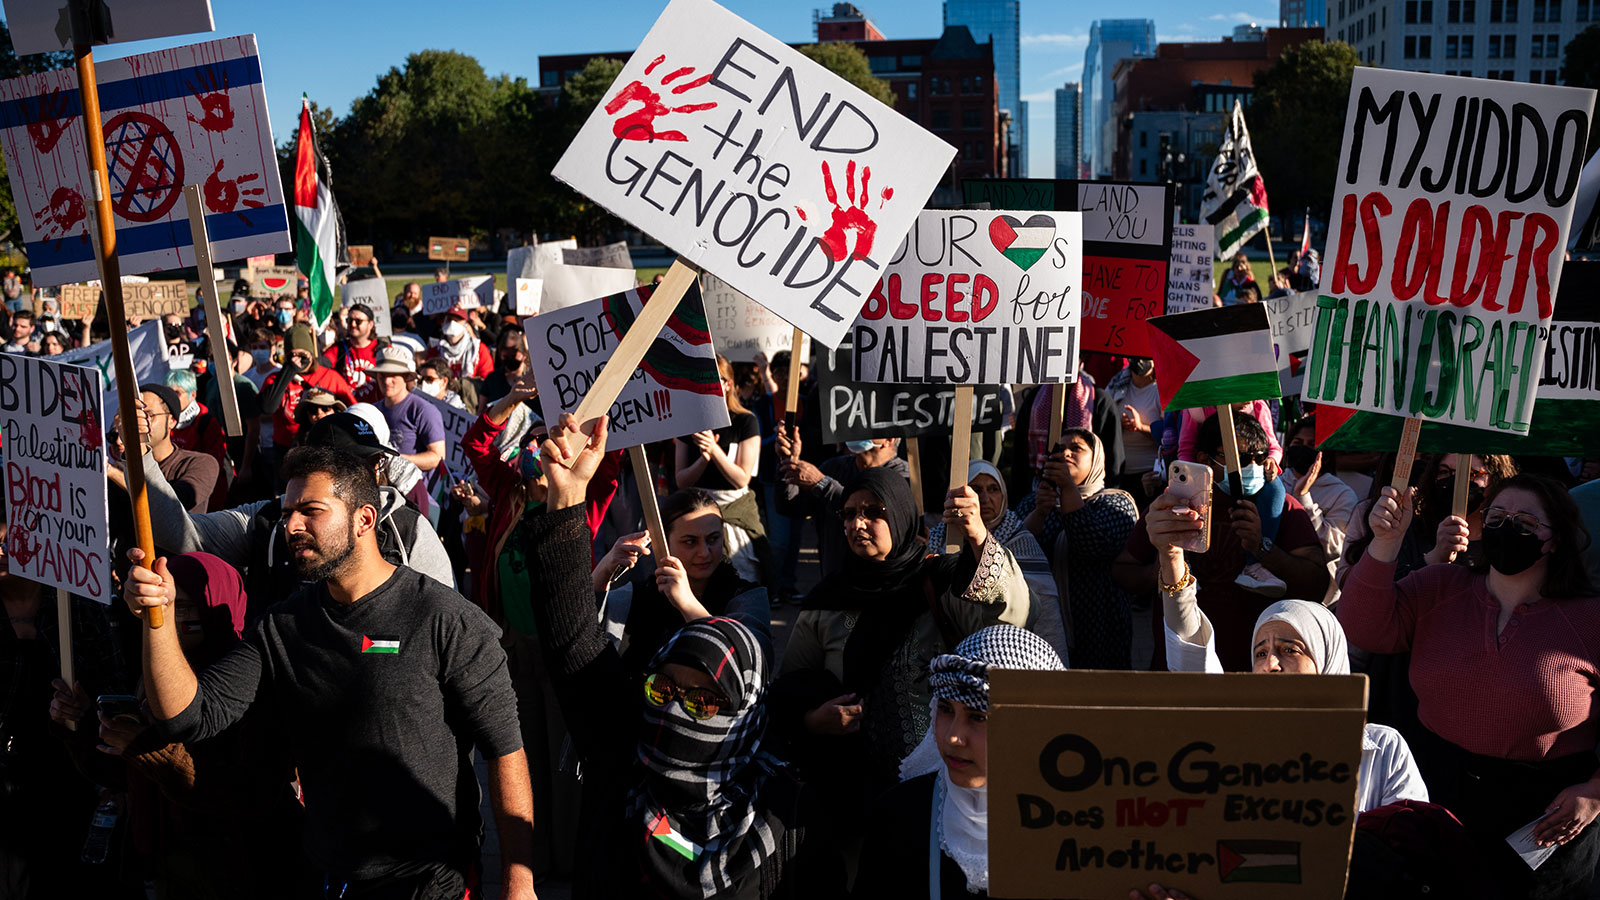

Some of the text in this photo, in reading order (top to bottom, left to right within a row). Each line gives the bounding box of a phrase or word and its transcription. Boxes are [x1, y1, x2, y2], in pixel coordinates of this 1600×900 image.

[708, 37, 879, 154] END
[703, 109, 791, 202] the
[1346, 86, 1442, 189] MY
[1420, 95, 1588, 208] JIDDO
[605, 124, 880, 323] GENOCIDE
[1022, 185, 1054, 209] YOU
[1105, 214, 1147, 240] YOU
[1136, 264, 1160, 292] TO
[1331, 191, 1560, 321] IS OLDER
[64, 288, 99, 301] FREE
[124, 299, 189, 317] GENOCIDE
[162, 283, 185, 299] THE
[861, 272, 1072, 325] BLEED for
[1127, 297, 1158, 320] FOR
[547, 310, 619, 372] STOP
[855, 324, 1077, 385] PALESTINE!
[1307, 294, 1413, 412] THAN
[0, 354, 102, 429] BIDEN
[7, 461, 87, 519] Blood is
[23, 509, 97, 547] on your
[1039, 733, 1160, 793] One
[1016, 793, 1105, 830] Does
[1055, 838, 1216, 876] Another
